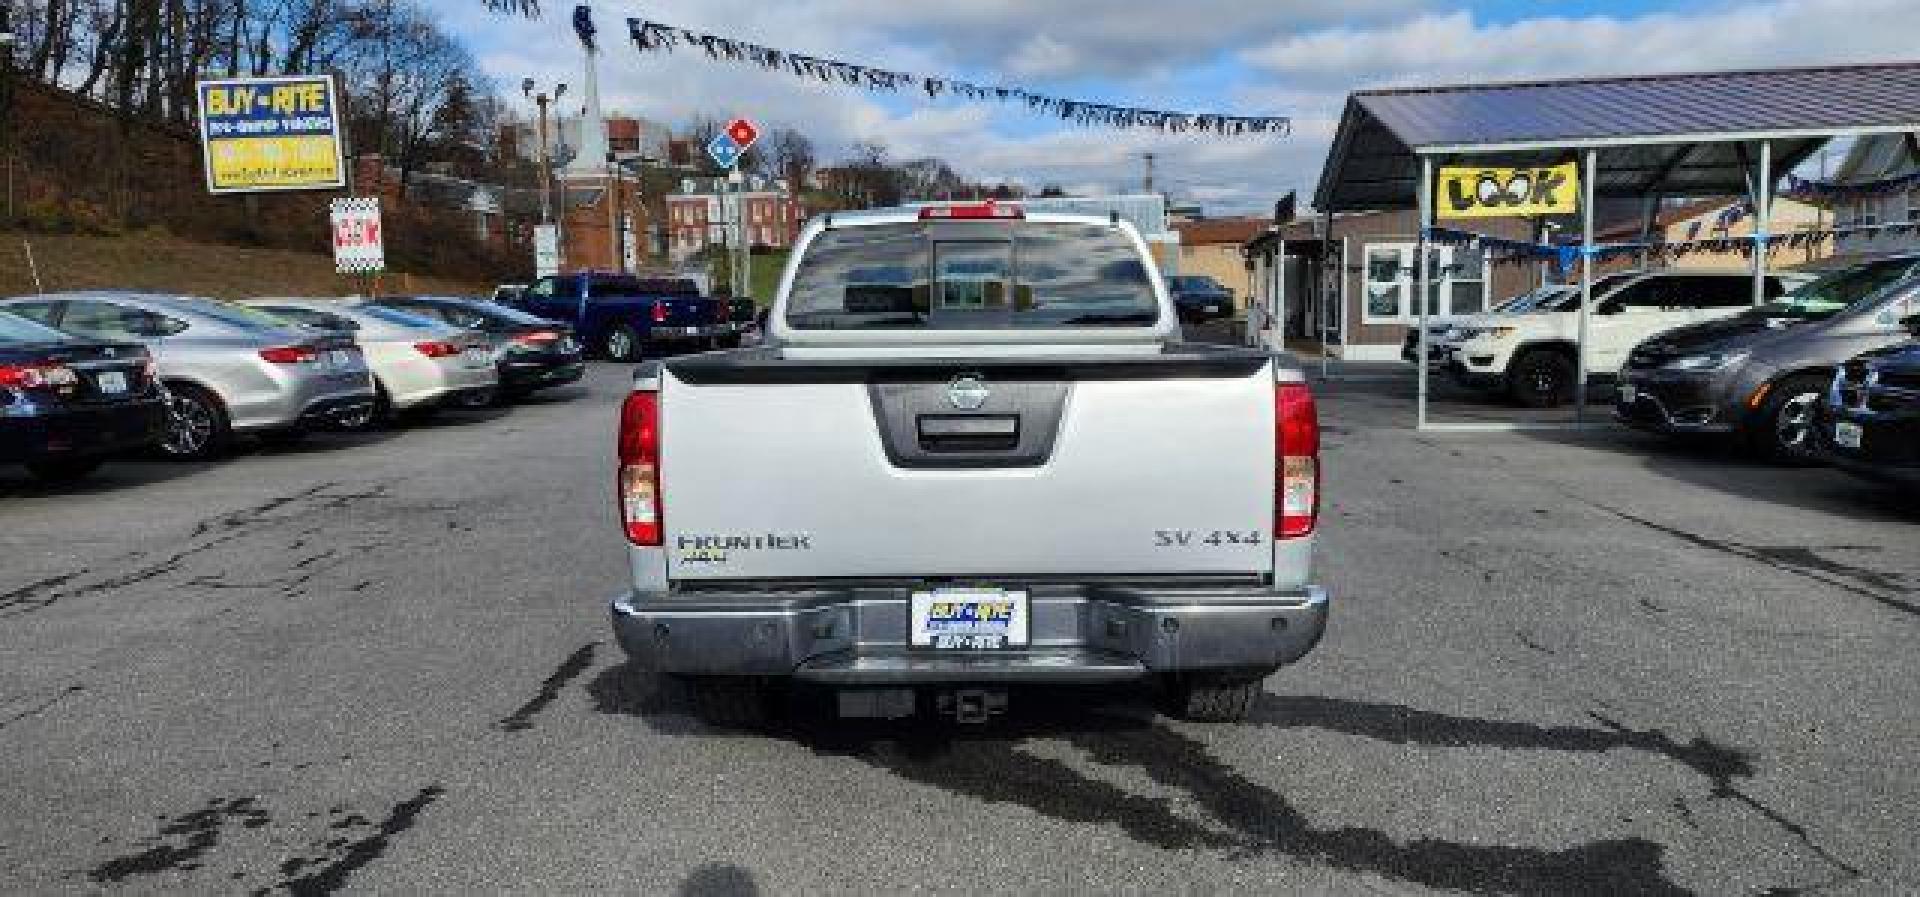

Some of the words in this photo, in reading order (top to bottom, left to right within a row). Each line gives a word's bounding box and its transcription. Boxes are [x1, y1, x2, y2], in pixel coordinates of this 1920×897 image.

[1447, 170, 1567, 210] LOOK
[677, 534, 812, 550] FRONTIER
[1154, 530, 1192, 546] SV
